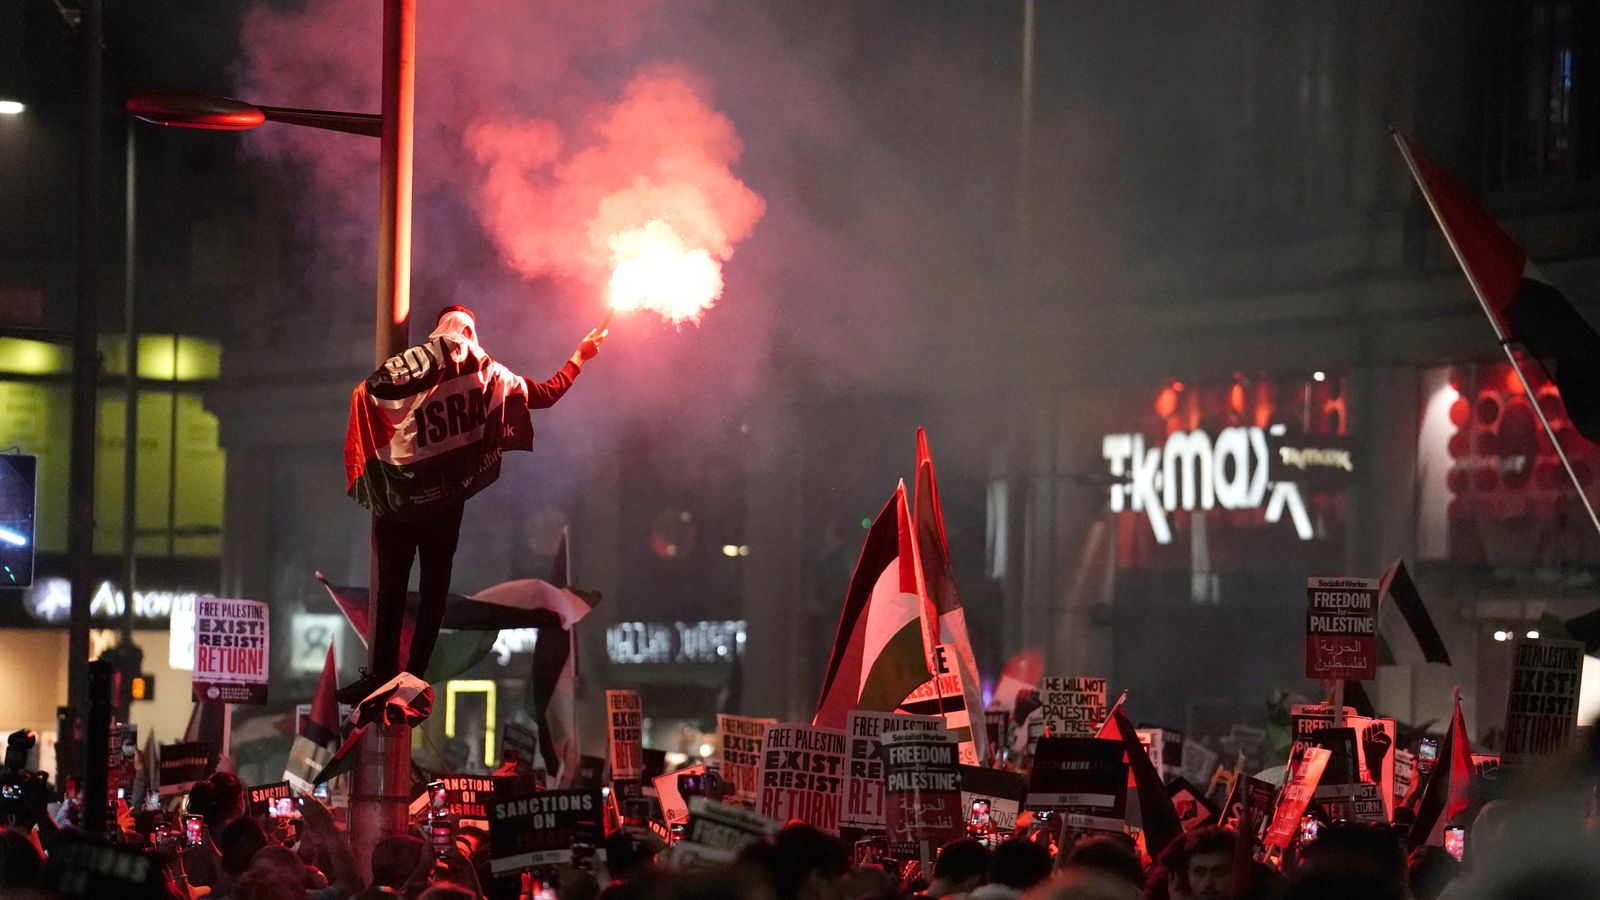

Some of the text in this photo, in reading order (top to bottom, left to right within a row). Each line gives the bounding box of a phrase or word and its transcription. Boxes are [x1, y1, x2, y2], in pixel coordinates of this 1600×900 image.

[1314, 592, 1371, 609] FREEDOM
[199, 602, 264, 619] FREE PALESTINE
[1337, 608, 1347, 616] for
[199, 618, 264, 635] EXIST!
[1310, 616, 1374, 633] PALESTINE
[198, 634, 264, 648] RESIST!
[1320, 639, 1361, 656] الحرية
[198, 647, 264, 675] RETURN!
[1314, 656, 1367, 671] لفلسطين
[1046, 678, 1106, 692] WE WILL NOT
[1514, 670, 1577, 695] EXIST!
[1048, 693, 1103, 706] REST UNTIL
[1042, 705, 1106, 720] PALESTINE
[1301, 707, 1327, 715] Socialist
[737, 720, 764, 736] PALESTIN
[853, 716, 879, 737] FREE
[1065, 720, 1089, 732] FREE
[723, 735, 762, 752] EXIST
[767, 729, 791, 748] FREE
[795, 729, 846, 754] PALESTIN
[889, 746, 951, 765] FREEDOM
[887, 772, 957, 791] PALESTINE
[462, 791, 476, 803] ON
[496, 794, 593, 819] SANCTIONS
[532, 812, 556, 830] ON
